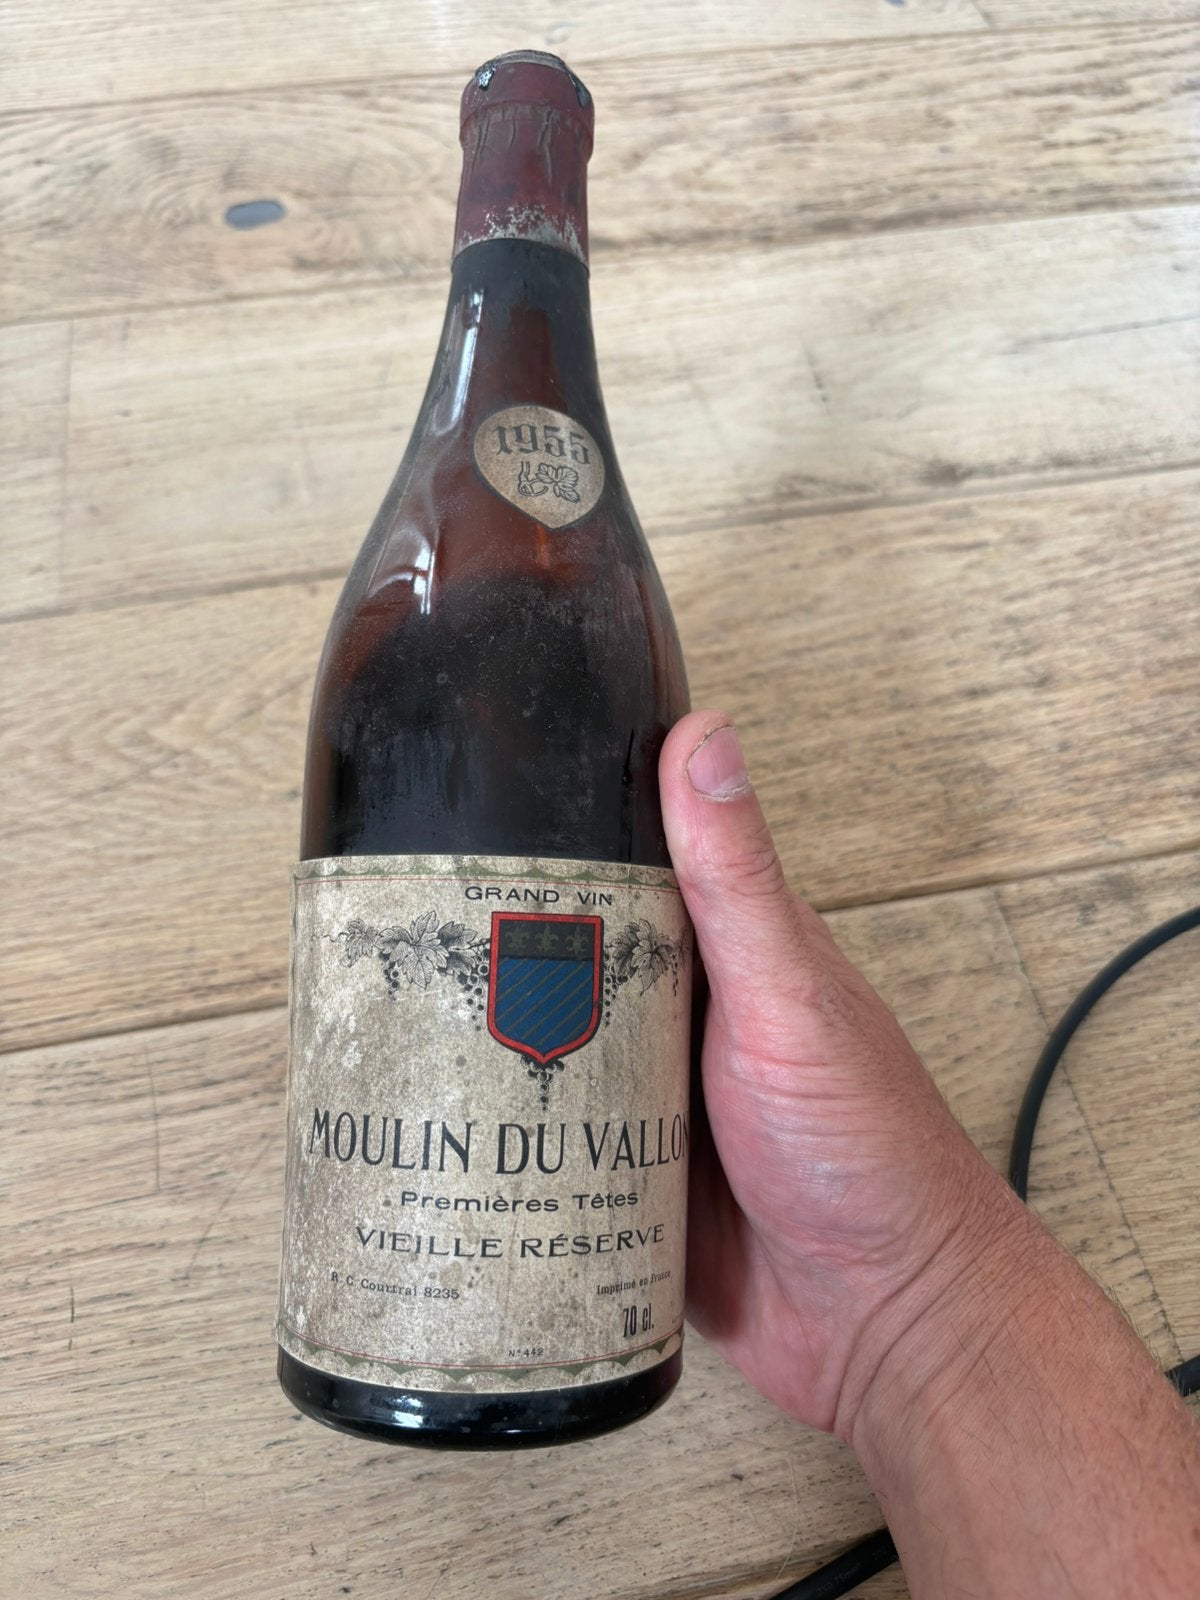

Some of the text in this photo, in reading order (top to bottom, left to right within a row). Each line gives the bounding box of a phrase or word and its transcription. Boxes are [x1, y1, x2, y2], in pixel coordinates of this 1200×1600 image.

[495, 423, 591, 465] 1955
[464, 886, 613, 906] GRAND VIN
[310, 1107, 471, 1173] MOULIN
[495, 1121, 567, 1175] DU
[401, 1190, 639, 1212] Premières Têtes
[355, 1224, 665, 1259] VIEILLE RÉSERVE
[360, 1278, 418, 1297] Courtrai
[423, 1286, 460, 1300] 8235
[639, 1276, 649, 1287] en
[650, 1269, 671, 1284] France
[622, 1304, 638, 1338] 70
[642, 1302, 655, 1332] cl.
